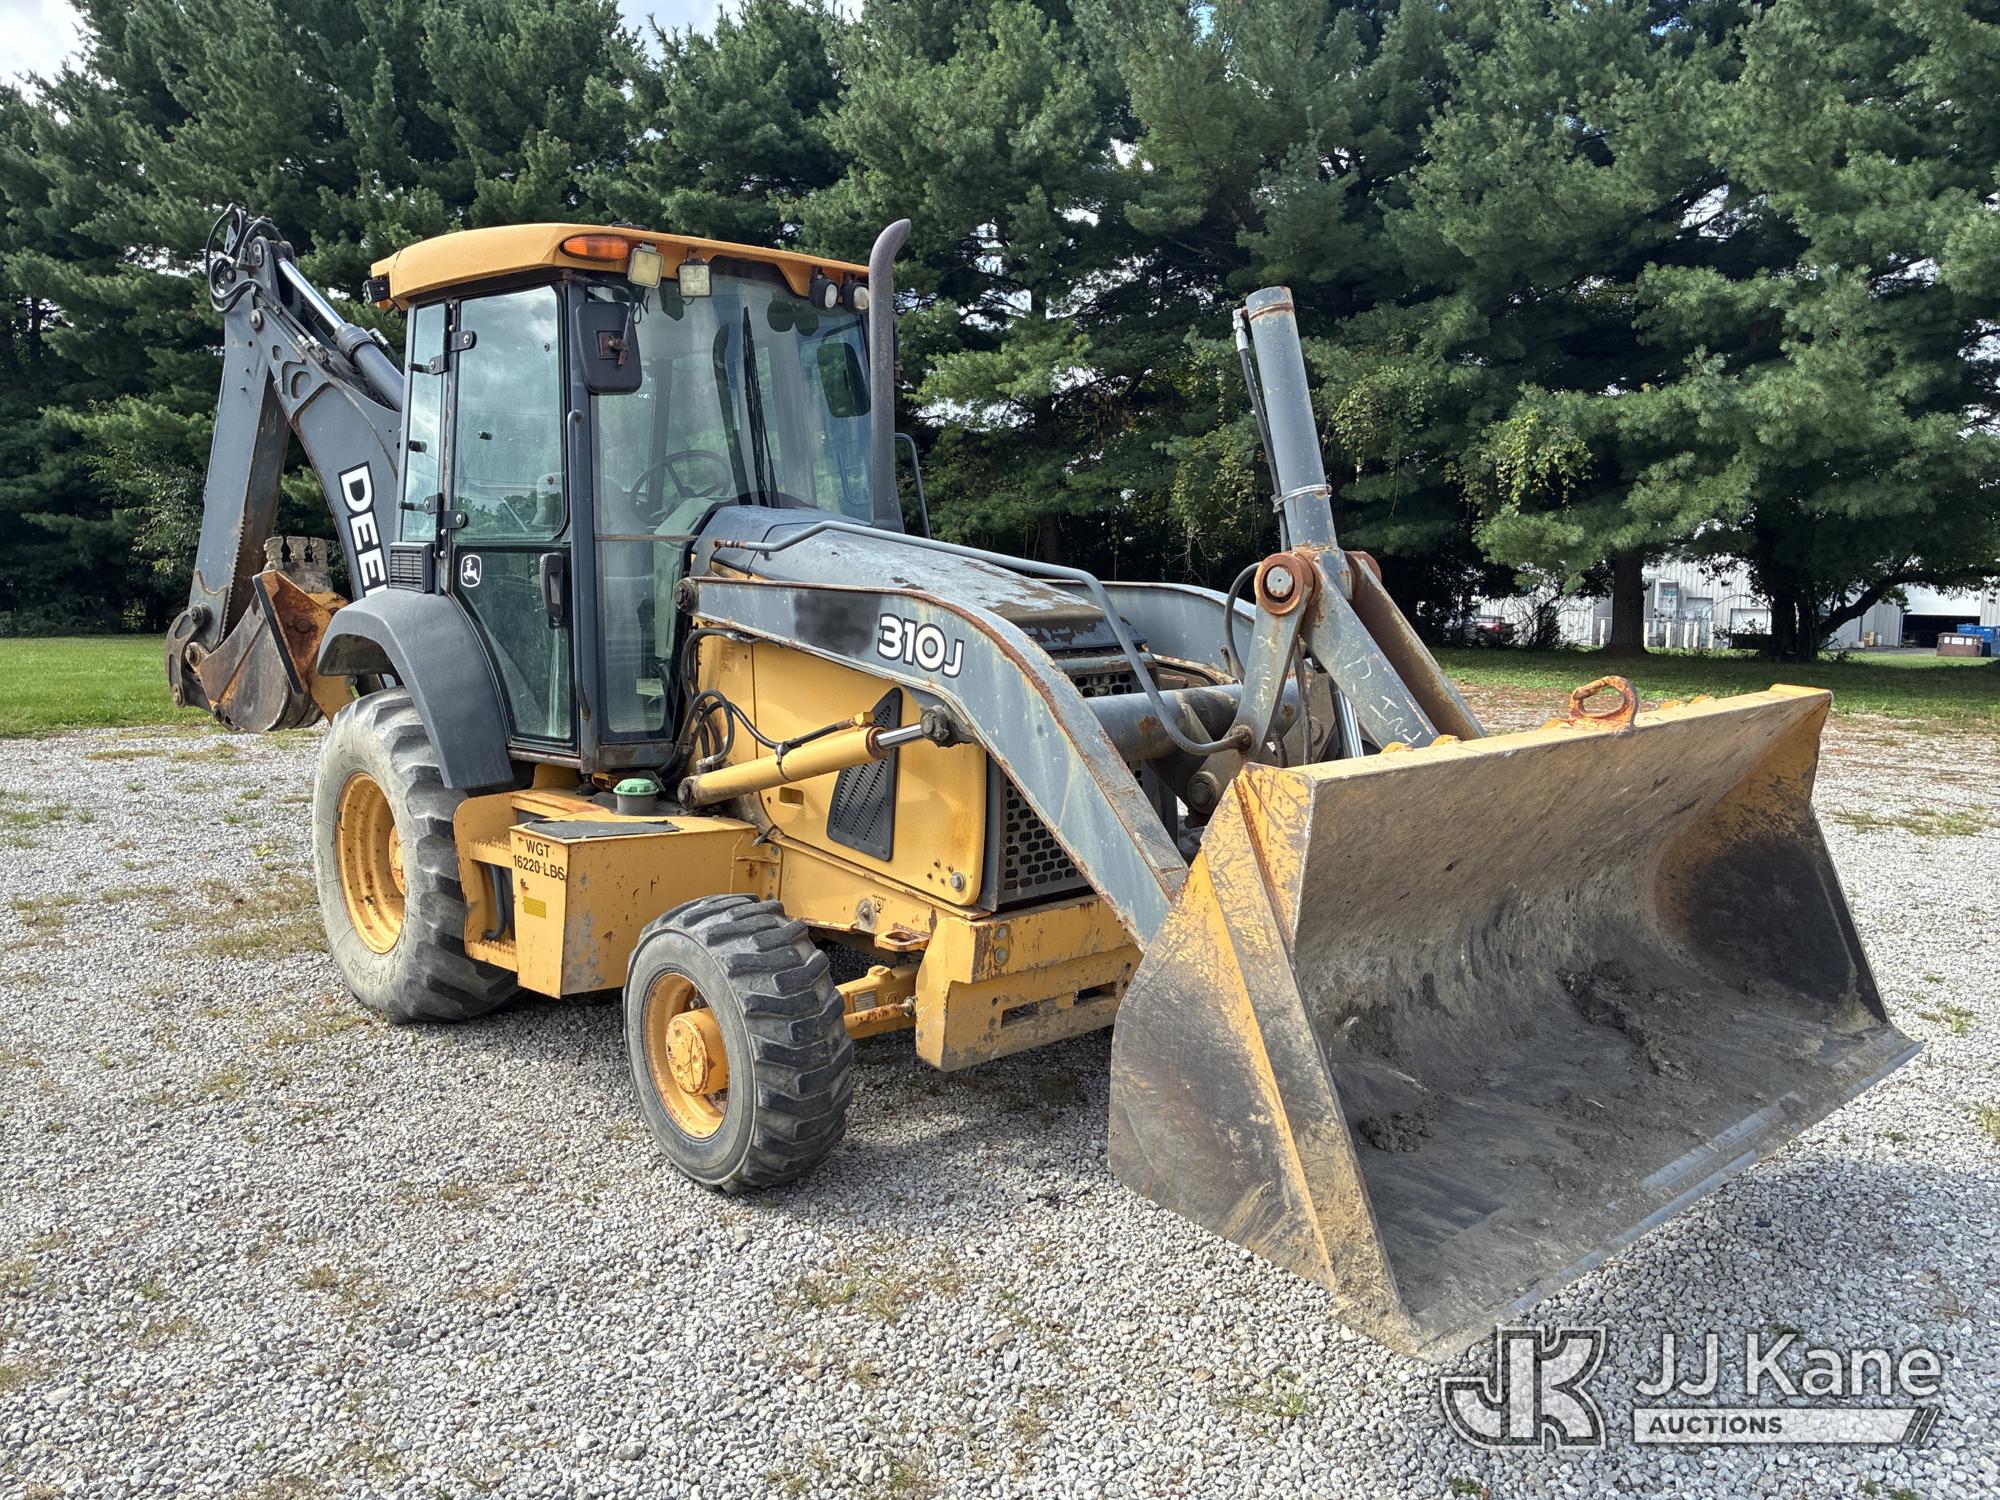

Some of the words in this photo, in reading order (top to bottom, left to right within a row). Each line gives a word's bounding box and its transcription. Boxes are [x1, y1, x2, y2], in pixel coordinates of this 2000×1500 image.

[338, 461, 389, 597] DEE
[877, 612, 965, 678] 310J
[512, 854, 541, 874] 16220
[543, 862, 566, 881] LBS
[525, 838, 551, 858] WGT
